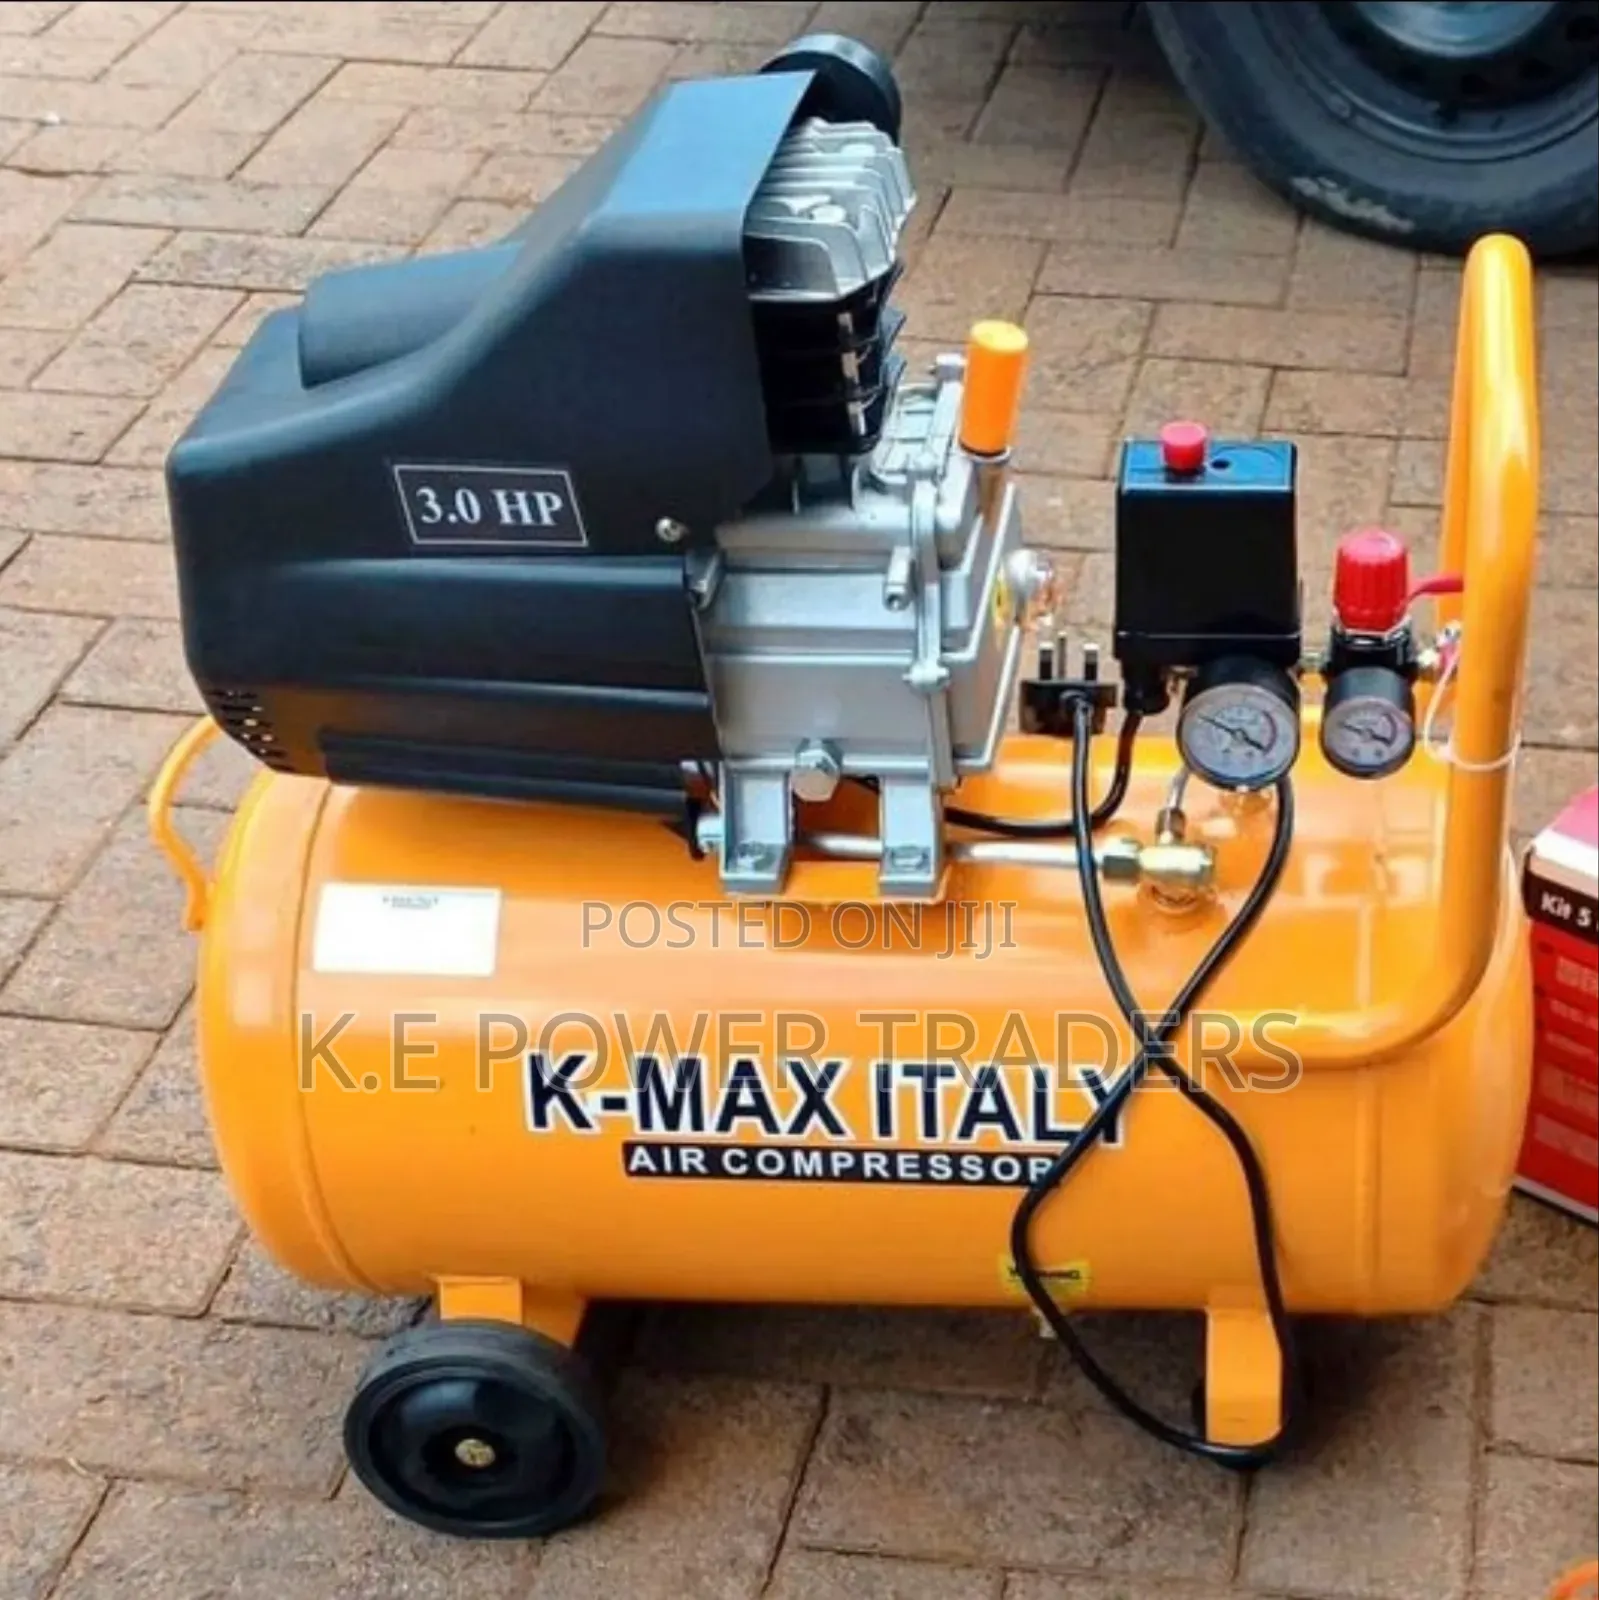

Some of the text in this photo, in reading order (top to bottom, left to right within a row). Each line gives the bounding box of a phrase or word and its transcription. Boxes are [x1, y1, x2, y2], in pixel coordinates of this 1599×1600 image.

[415, 486, 563, 526] 3.0 HP
[526, 1050, 1126, 1145] K-MAX ITALY
[628, 1146, 708, 1175] AIR
